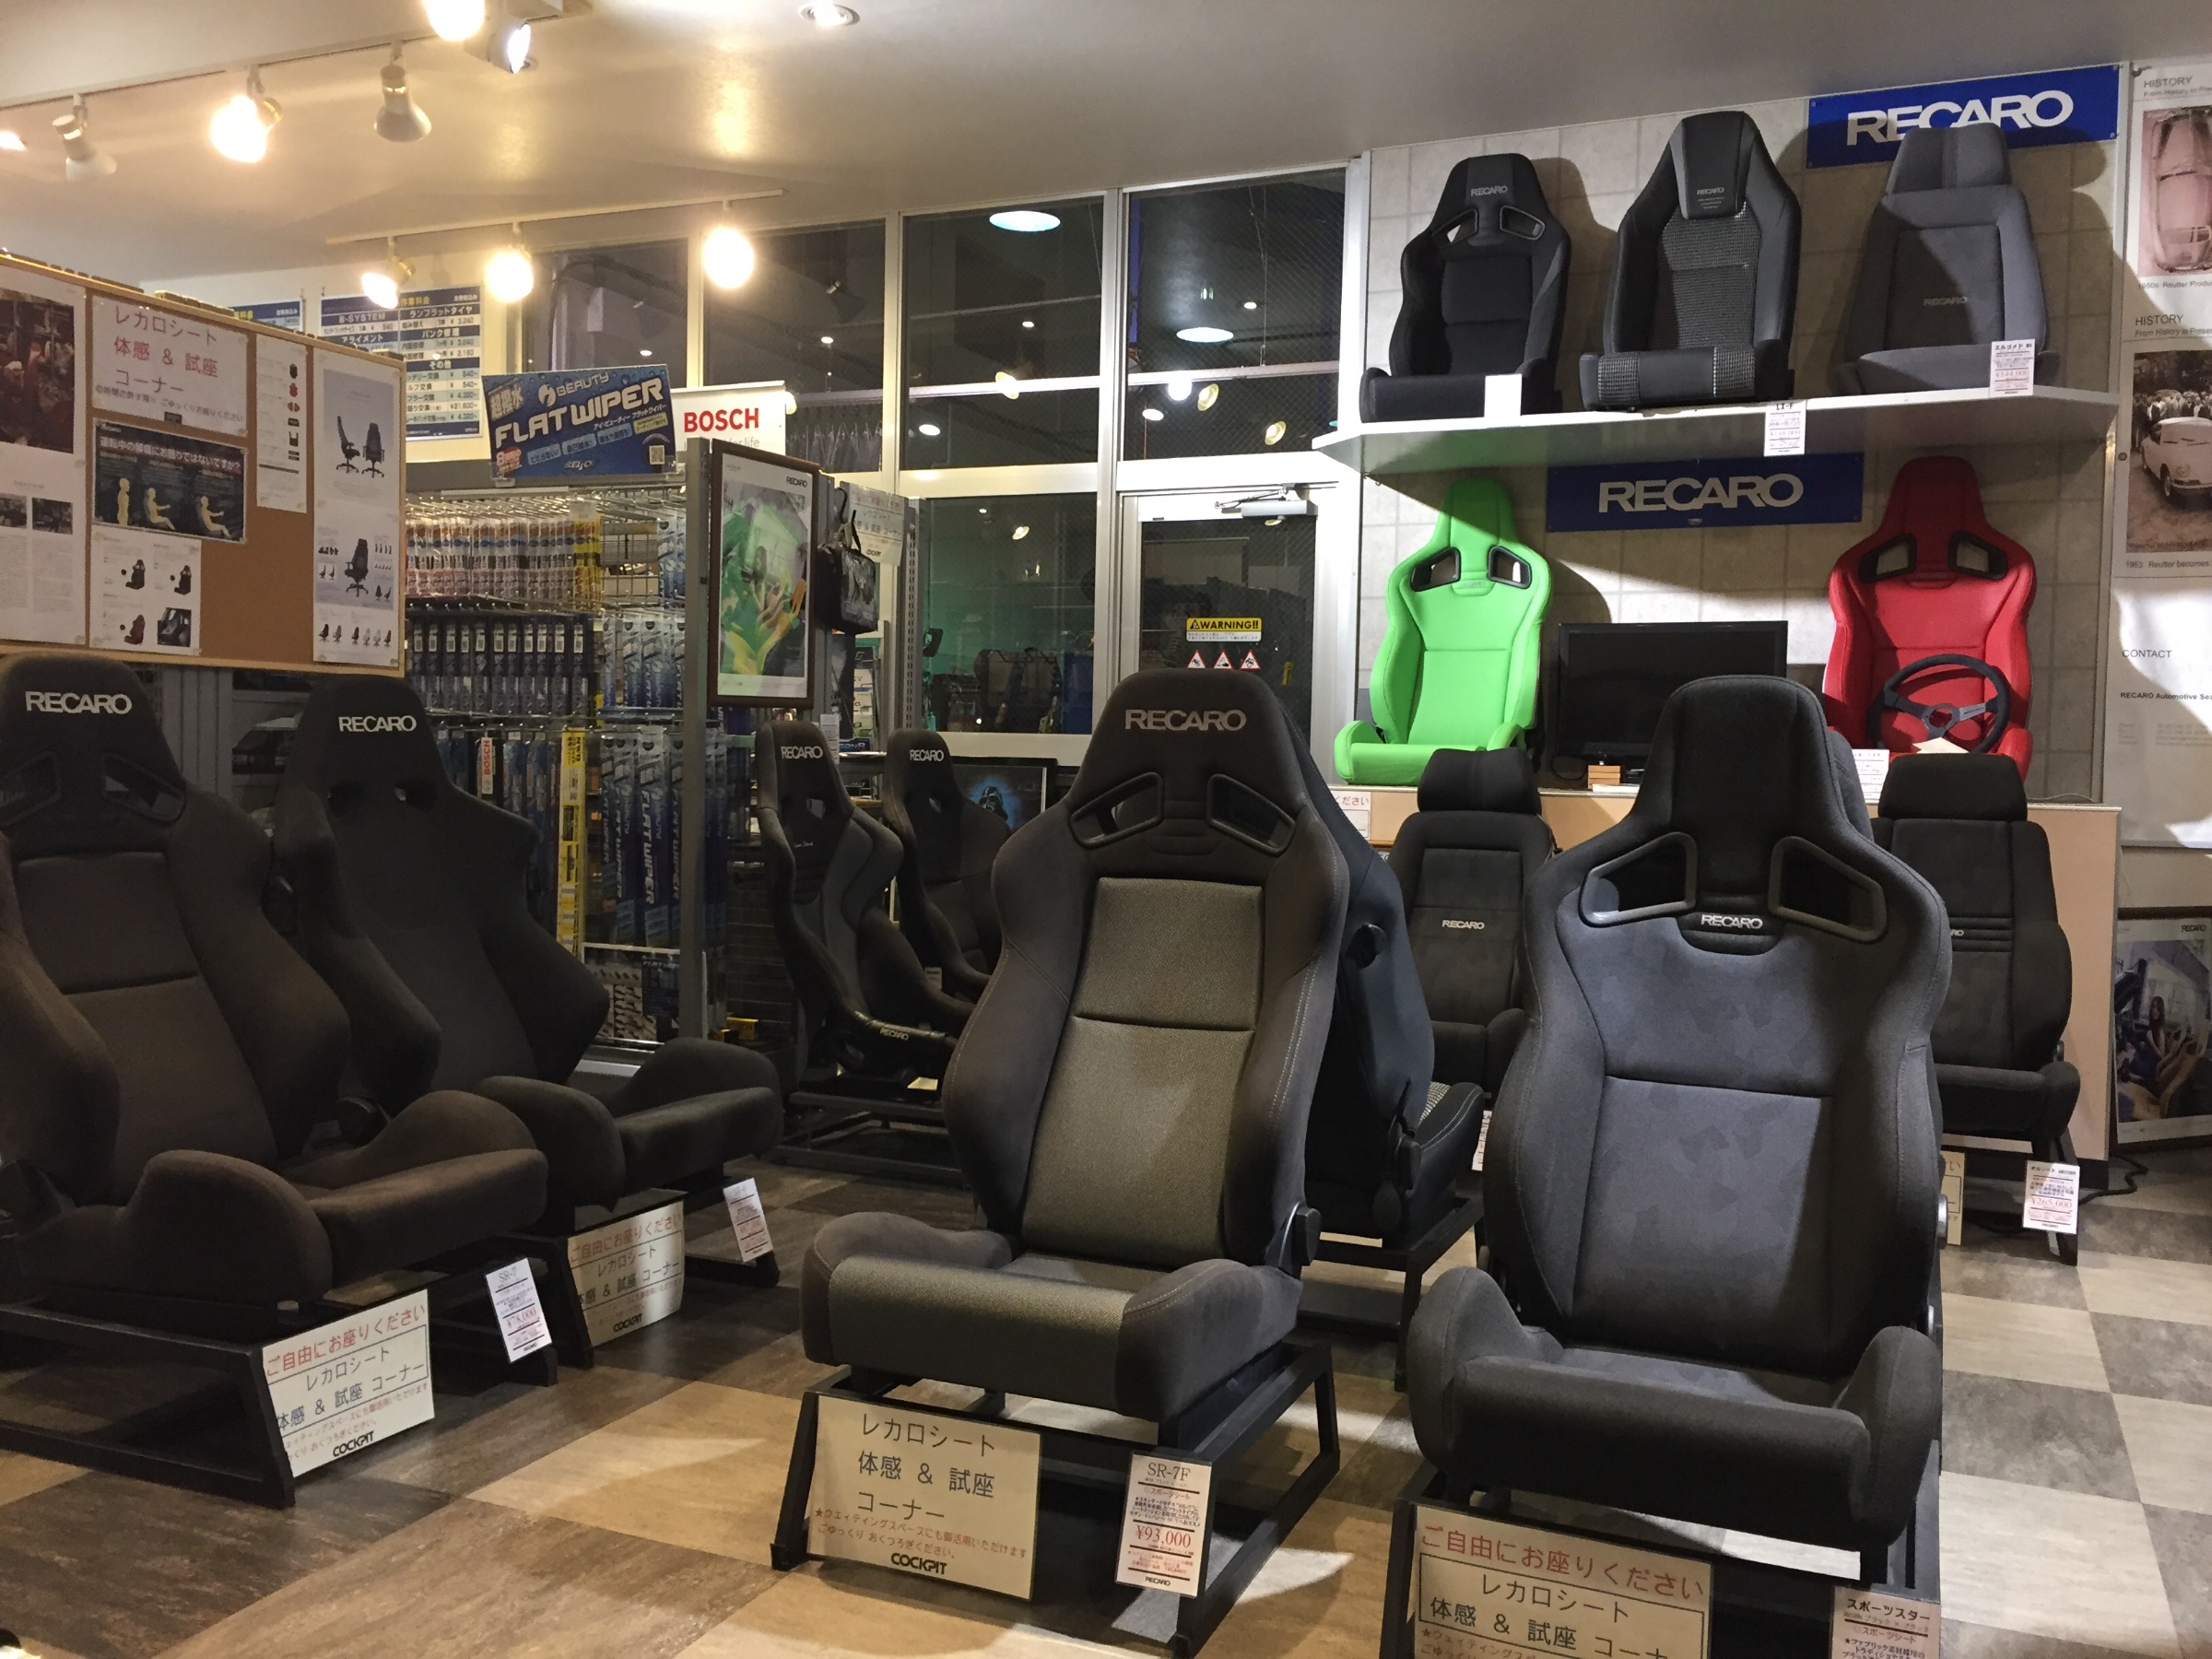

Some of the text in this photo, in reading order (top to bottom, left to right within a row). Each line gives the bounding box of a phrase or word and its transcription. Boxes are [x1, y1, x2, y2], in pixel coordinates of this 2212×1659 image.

[2144, 76, 2193, 88] HISTORY
[1847, 90, 2074, 146] RECARO
[1471, 185, 1508, 197] RECARO
[1697, 187, 1724, 195] RECARO
[1924, 296, 1968, 306] RECARO
[410, 306, 473, 318] ランフラットタイヤ
[2136, 314, 2183, 325] HISTORY
[116, 306, 217, 346] レカロシート
[342, 334, 383, 345] アライメント
[114, 335, 218, 377] 体感 & 試座
[115, 369, 183, 393] コーナー
[684, 407, 759, 432] BOSCH
[744, 437, 760, 448] life
[1598, 473, 1804, 513] RECARO
[2148, 559, 2175, 568] Reutter
[2177, 559, 2209, 568] becomes
[1200, 619, 1259, 629] WARNING!!
[2122, 650, 2172, 659] CONTACT
[26, 691, 132, 715] RECARO
[2155, 692, 2198, 700] Automotive
[338, 715, 417, 733] RECARO
[1124, 709, 1247, 733] RECARO
[781, 746, 824, 759] RECARO
[910, 748, 944, 762] RECARO
[1441, 919, 1485, 930] RECARO
[1700, 912, 1763, 930] RECARO
[879, 1027, 909, 1041] RECARO
[571, 1213, 682, 1263] ご自由にお座りください
[597, 1245, 656, 1277] レカロシート
[499, 1266, 516, 1282] SR-7
[602, 1284, 611, 1298] &
[642, 1262, 680, 1282] コーナー
[613, 1313, 643, 1333] COCKPIT
[267, 1304, 426, 1377] ご自由にお座りください
[306, 1347, 390, 1392] レカロシート
[314, 1399, 325, 1416] &
[335, 1382, 363, 1409] 試座
[372, 1363, 424, 1392] コーナー
[332, 1430, 374, 1458] COCKPIT
[862, 1413, 994, 1457] レカロシート
[858, 1450, 995, 1499] 体感 & 試座
[1147, 1462, 1192, 1482] SR-7F
[858, 1491, 945, 1521] コーナー
[818, 1524, 864, 1540] ごゆっくり
[890, 1552, 947, 1575] COCKPIT
[1423, 1525, 1704, 1600] ご自由にお座りください
[1146, 1576, 1171, 1587] RECARO
[1482, 1573, 1629, 1623] レカロシート
[1846, 1598, 1931, 1621] スポーツスター
[1430, 1596, 1477, 1628] 体感
[1493, 1614, 1511, 1635] &
[1528, 1618, 1577, 1648] 試座
[1861, 1626, 1916, 1644] スポーツシート
